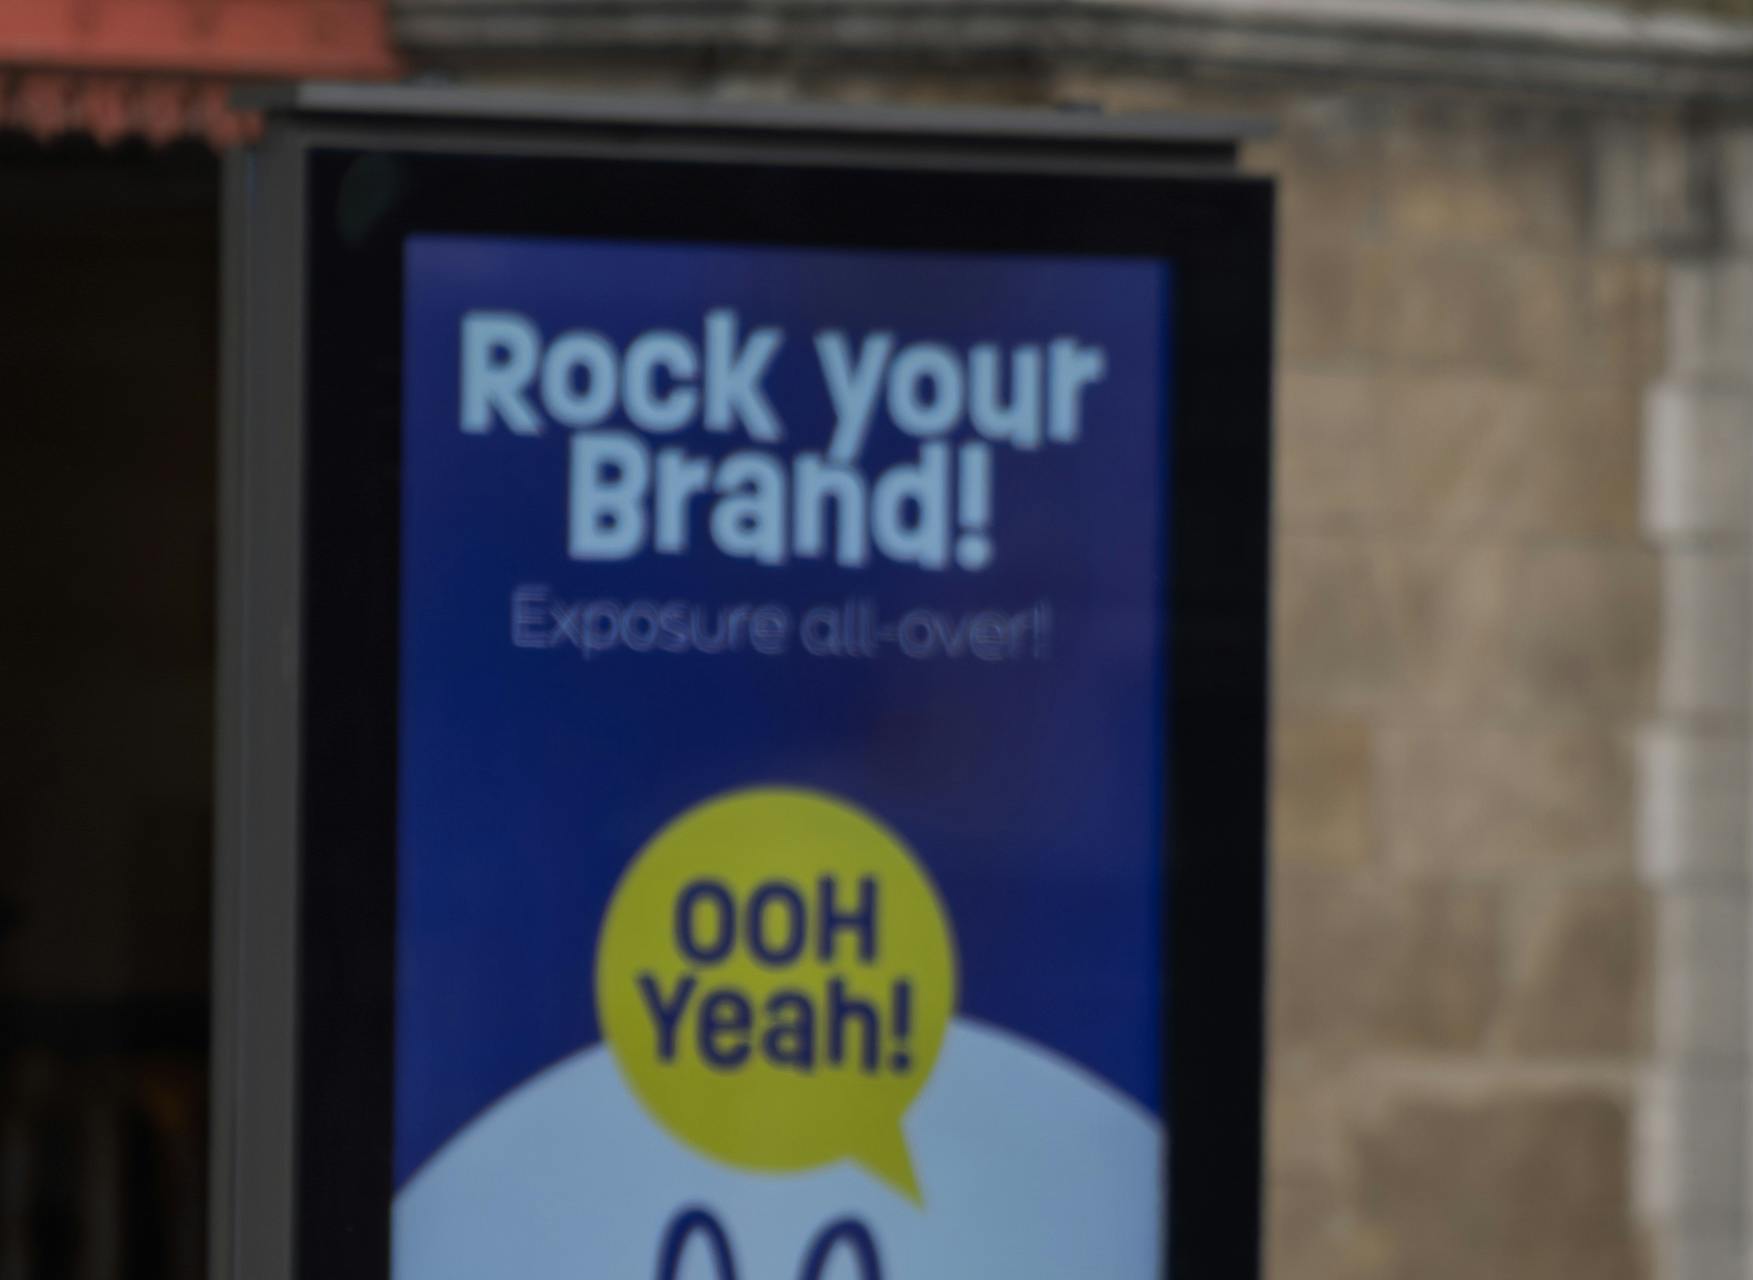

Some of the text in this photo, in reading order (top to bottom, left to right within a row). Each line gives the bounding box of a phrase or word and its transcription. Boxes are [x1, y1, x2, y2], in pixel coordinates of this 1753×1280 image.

[460, 307, 1107, 463] Rock your
[567, 428, 995, 571] Brand!
[510, 584, 1052, 662] Exposure all-over!
[673, 872, 880, 970] OOH
[633, 969, 912, 1075] Yeah!
